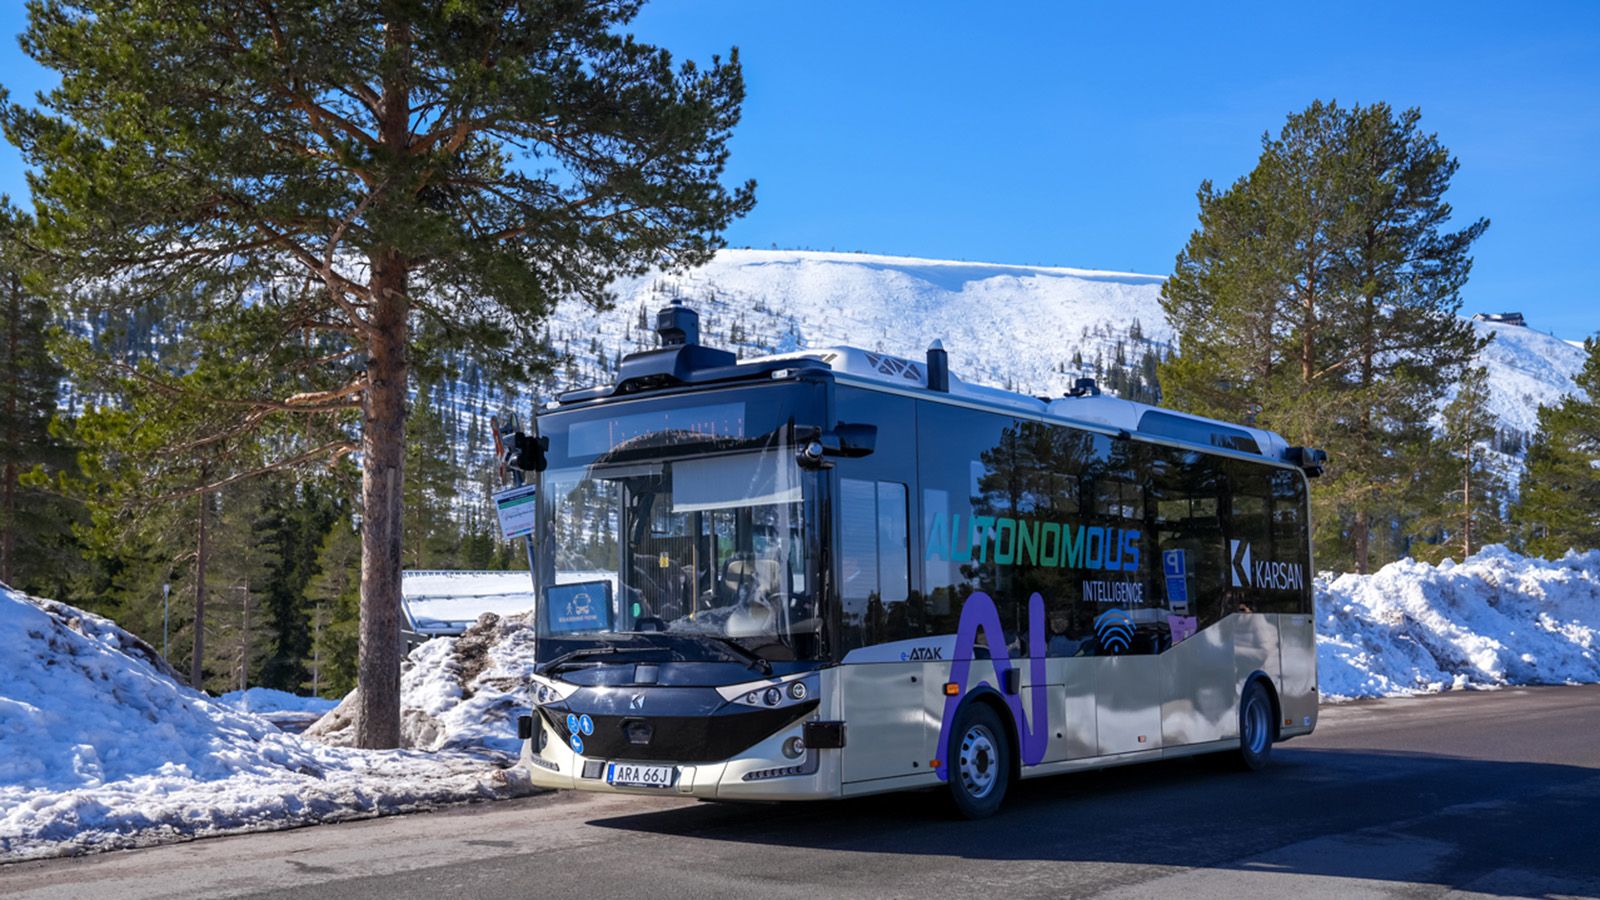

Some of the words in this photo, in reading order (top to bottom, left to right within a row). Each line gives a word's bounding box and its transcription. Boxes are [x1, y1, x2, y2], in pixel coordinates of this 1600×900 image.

[926, 512, 1141, 572] AUTONOMOUS
[1255, 560, 1303, 591] KARSAN
[1082, 580, 1144, 603] INTELLIGENCE
[617, 766, 640, 782] ARA
[643, 767, 668, 783] 66J
